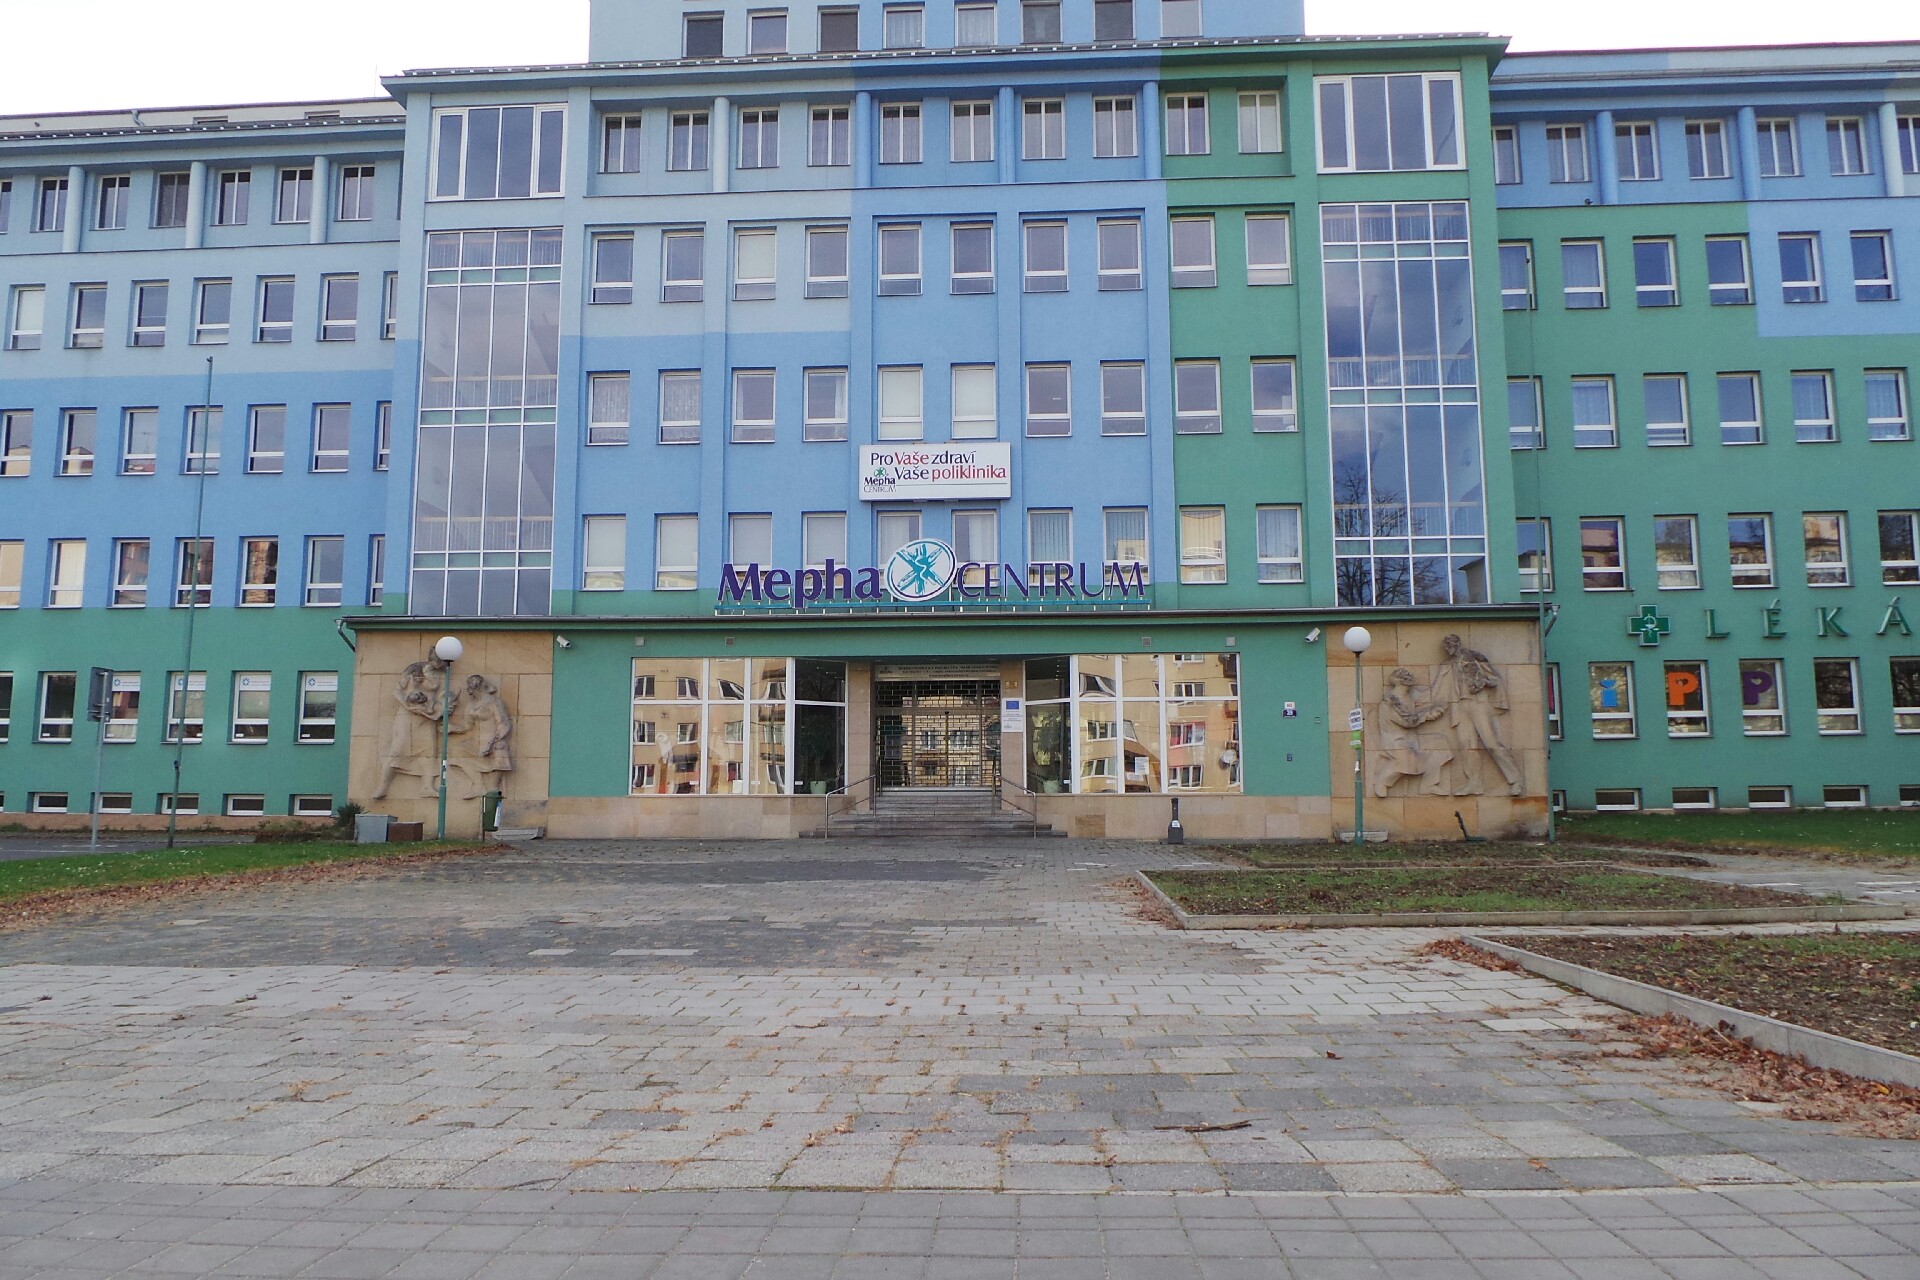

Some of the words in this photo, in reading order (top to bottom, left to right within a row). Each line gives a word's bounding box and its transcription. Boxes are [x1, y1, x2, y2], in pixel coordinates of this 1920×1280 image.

[871, 452, 893, 465] Pro
[894, 451, 929, 465] Vaše
[931, 451, 976, 464] zdraví
[864, 476, 896, 486] Mepha
[894, 466, 929, 480] Vaše
[932, 465, 1006, 482] poliklinika
[716, 558, 883, 608] Mepha
[957, 561, 1146, 598] CENTRUM
